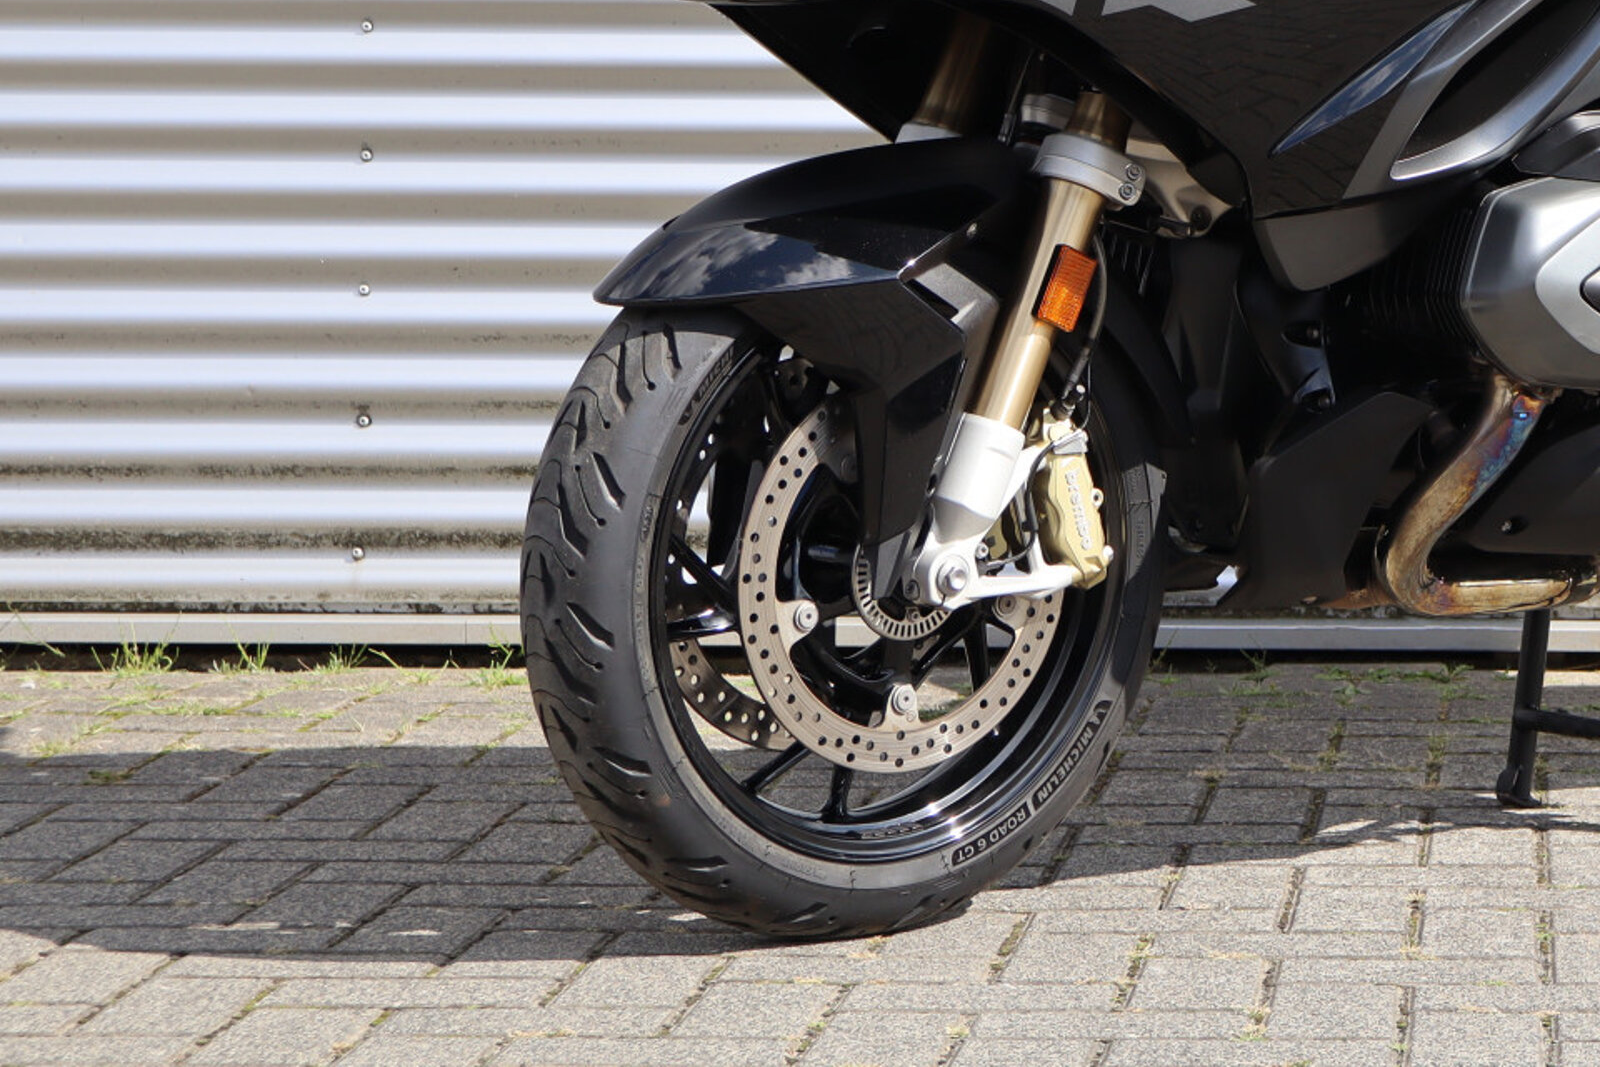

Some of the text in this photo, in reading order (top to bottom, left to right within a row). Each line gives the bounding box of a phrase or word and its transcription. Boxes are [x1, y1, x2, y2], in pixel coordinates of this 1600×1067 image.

[1064, 469, 1093, 551] brembo
[1036, 726, 1094, 803] MICHELIN
[957, 808, 1026, 863] ROAD 6 GT
